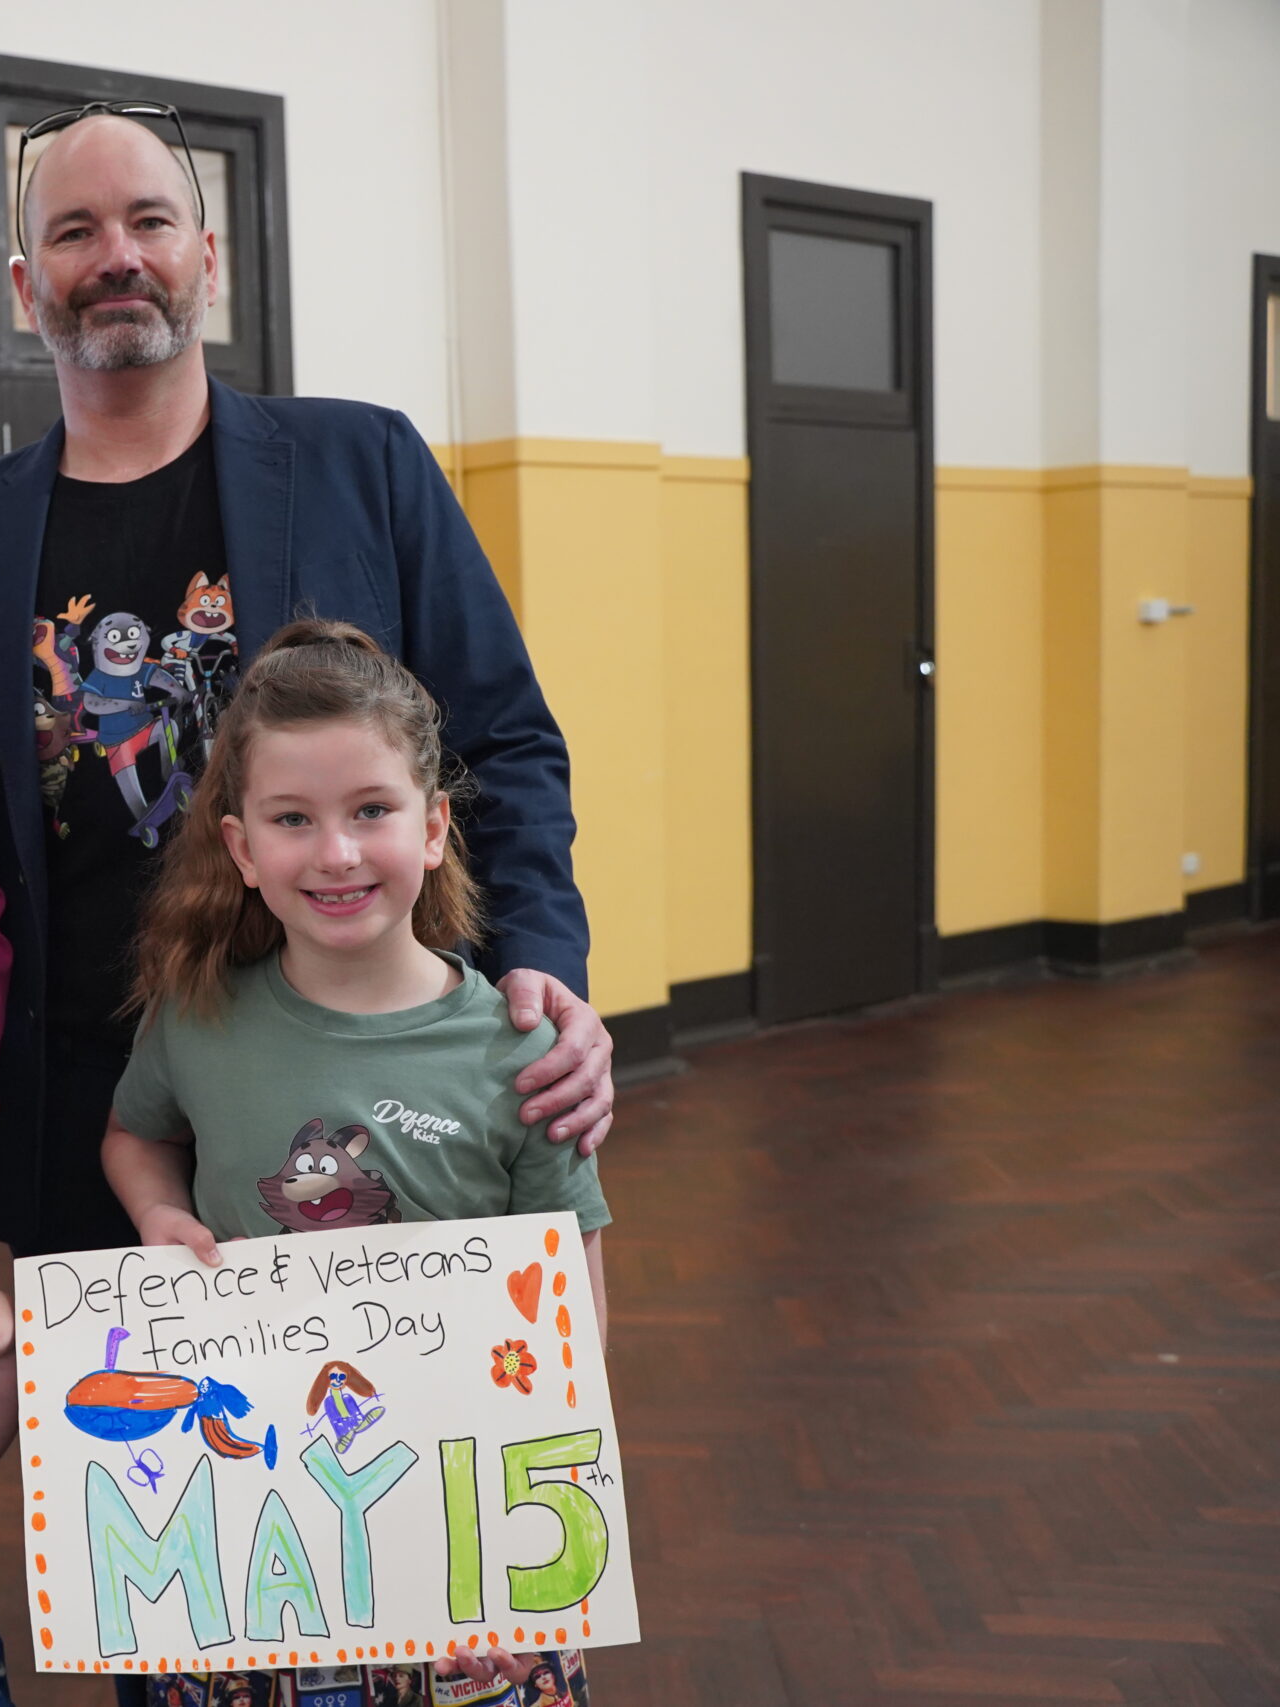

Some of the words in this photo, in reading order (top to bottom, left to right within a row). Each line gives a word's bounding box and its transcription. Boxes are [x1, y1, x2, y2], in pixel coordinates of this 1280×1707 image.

[372, 1099, 461, 1135] Defence
[412, 1127, 440, 1144] Kidz
[37, 1251, 259, 1330] Defence
[268, 1244, 291, 1292] &
[307, 1236, 493, 1295] Veterans
[142, 1316, 330, 1371] Families
[352, 1301, 446, 1357] Day
[84, 1433, 420, 1660] MAY
